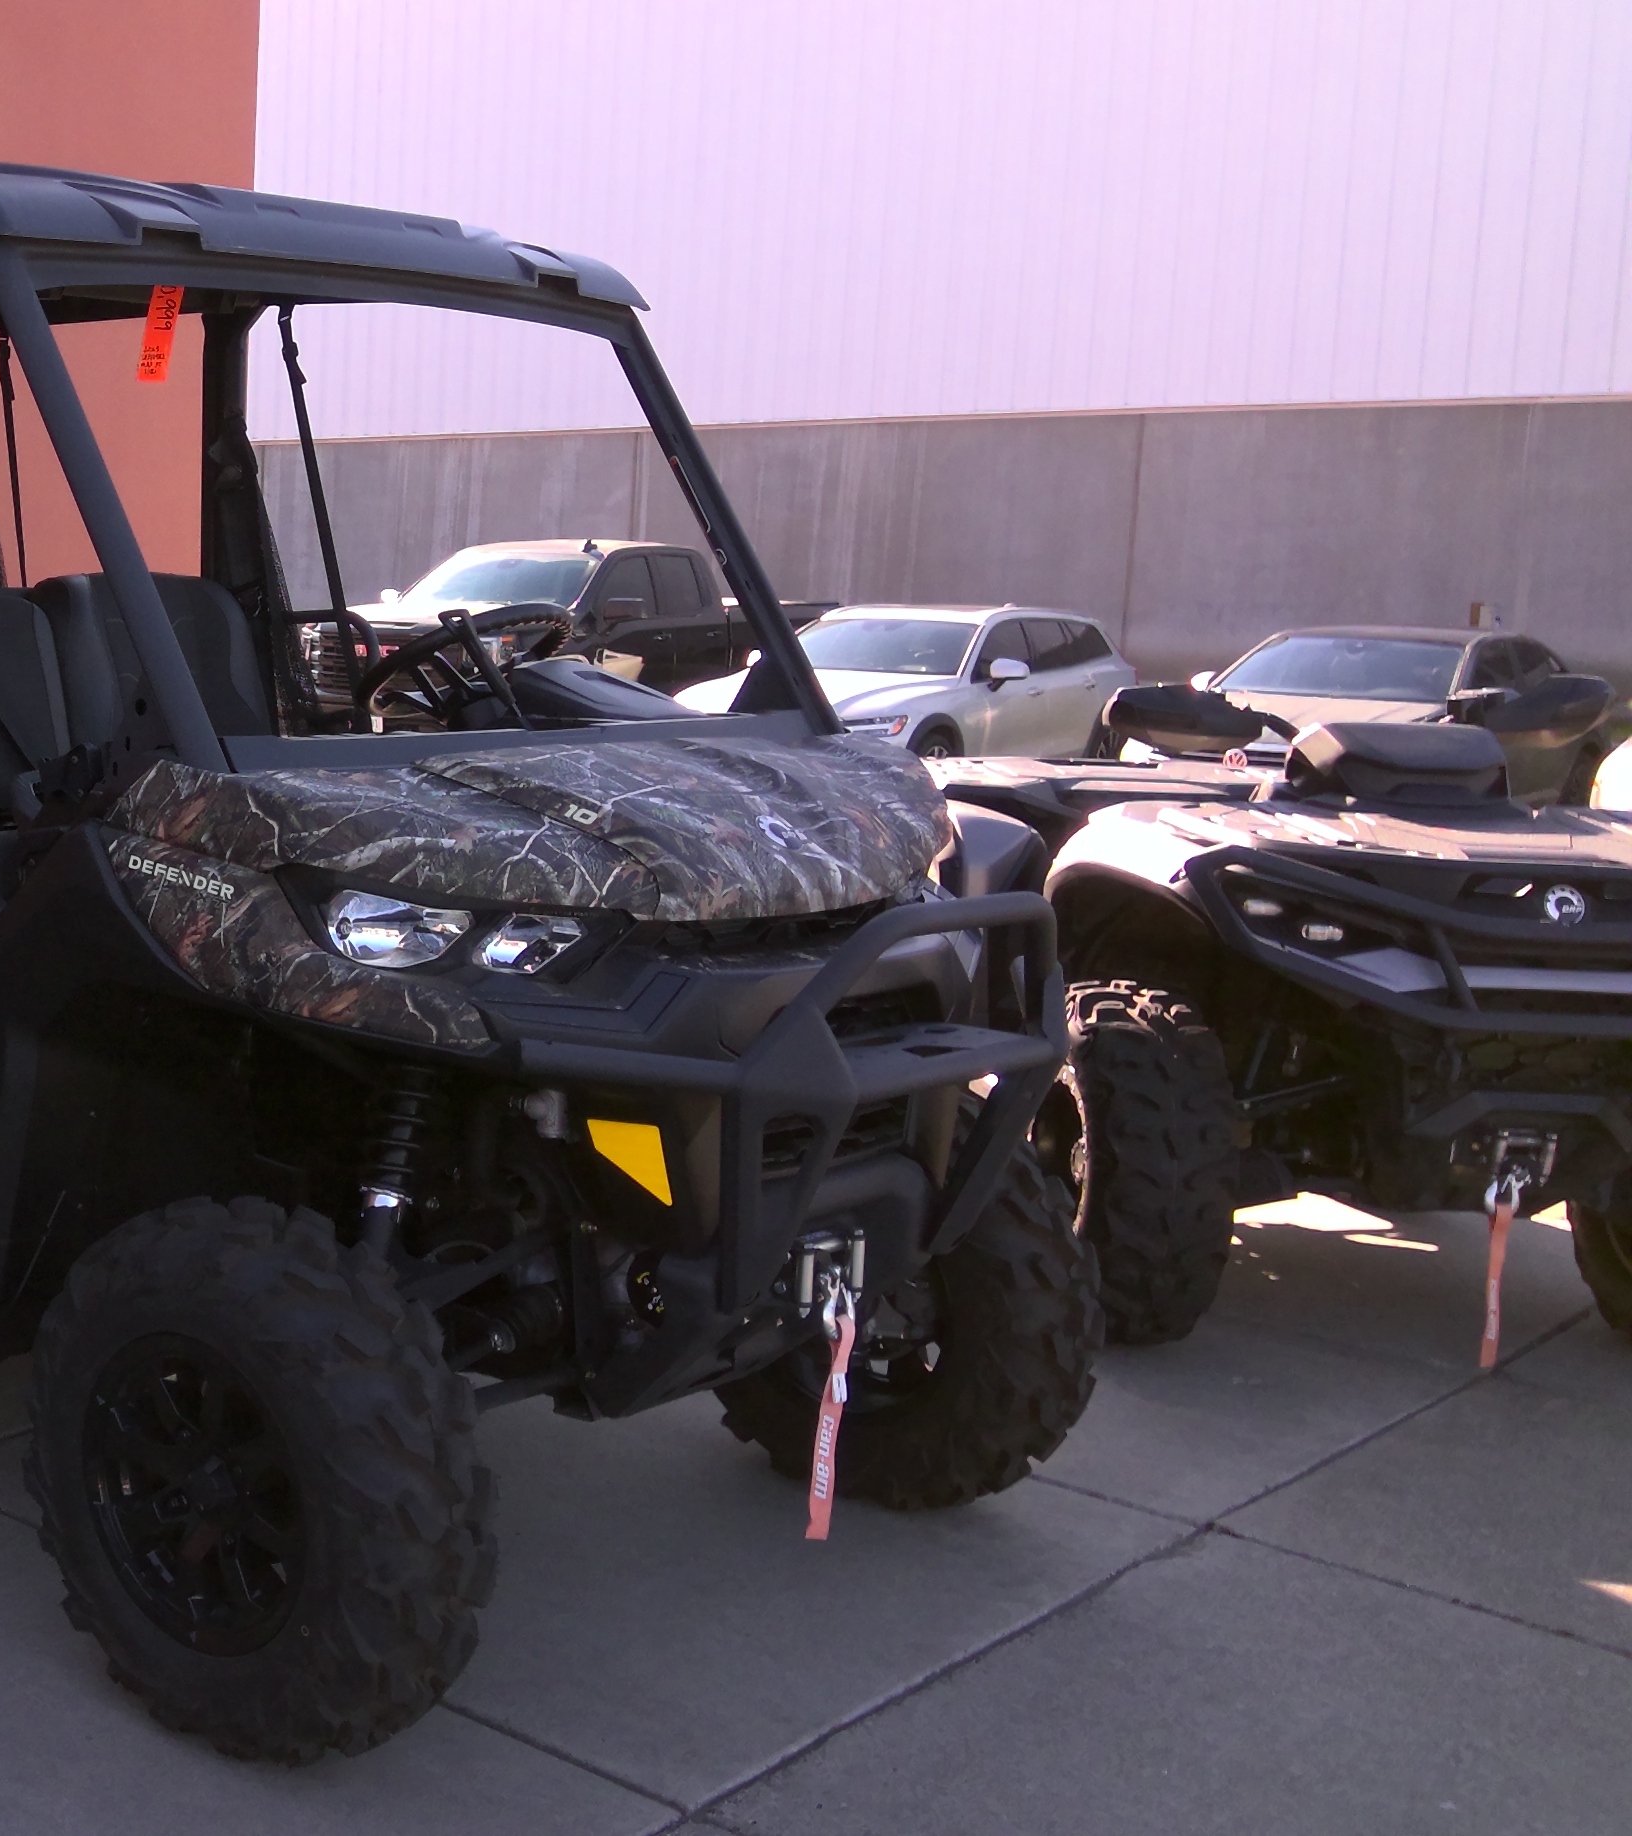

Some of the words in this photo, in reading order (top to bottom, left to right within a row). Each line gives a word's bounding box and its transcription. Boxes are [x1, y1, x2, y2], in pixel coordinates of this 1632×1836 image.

[564, 803, 598, 825] 10
[128, 856, 235, 900] DEFENDER
[814, 1414, 835, 1500] can-am
